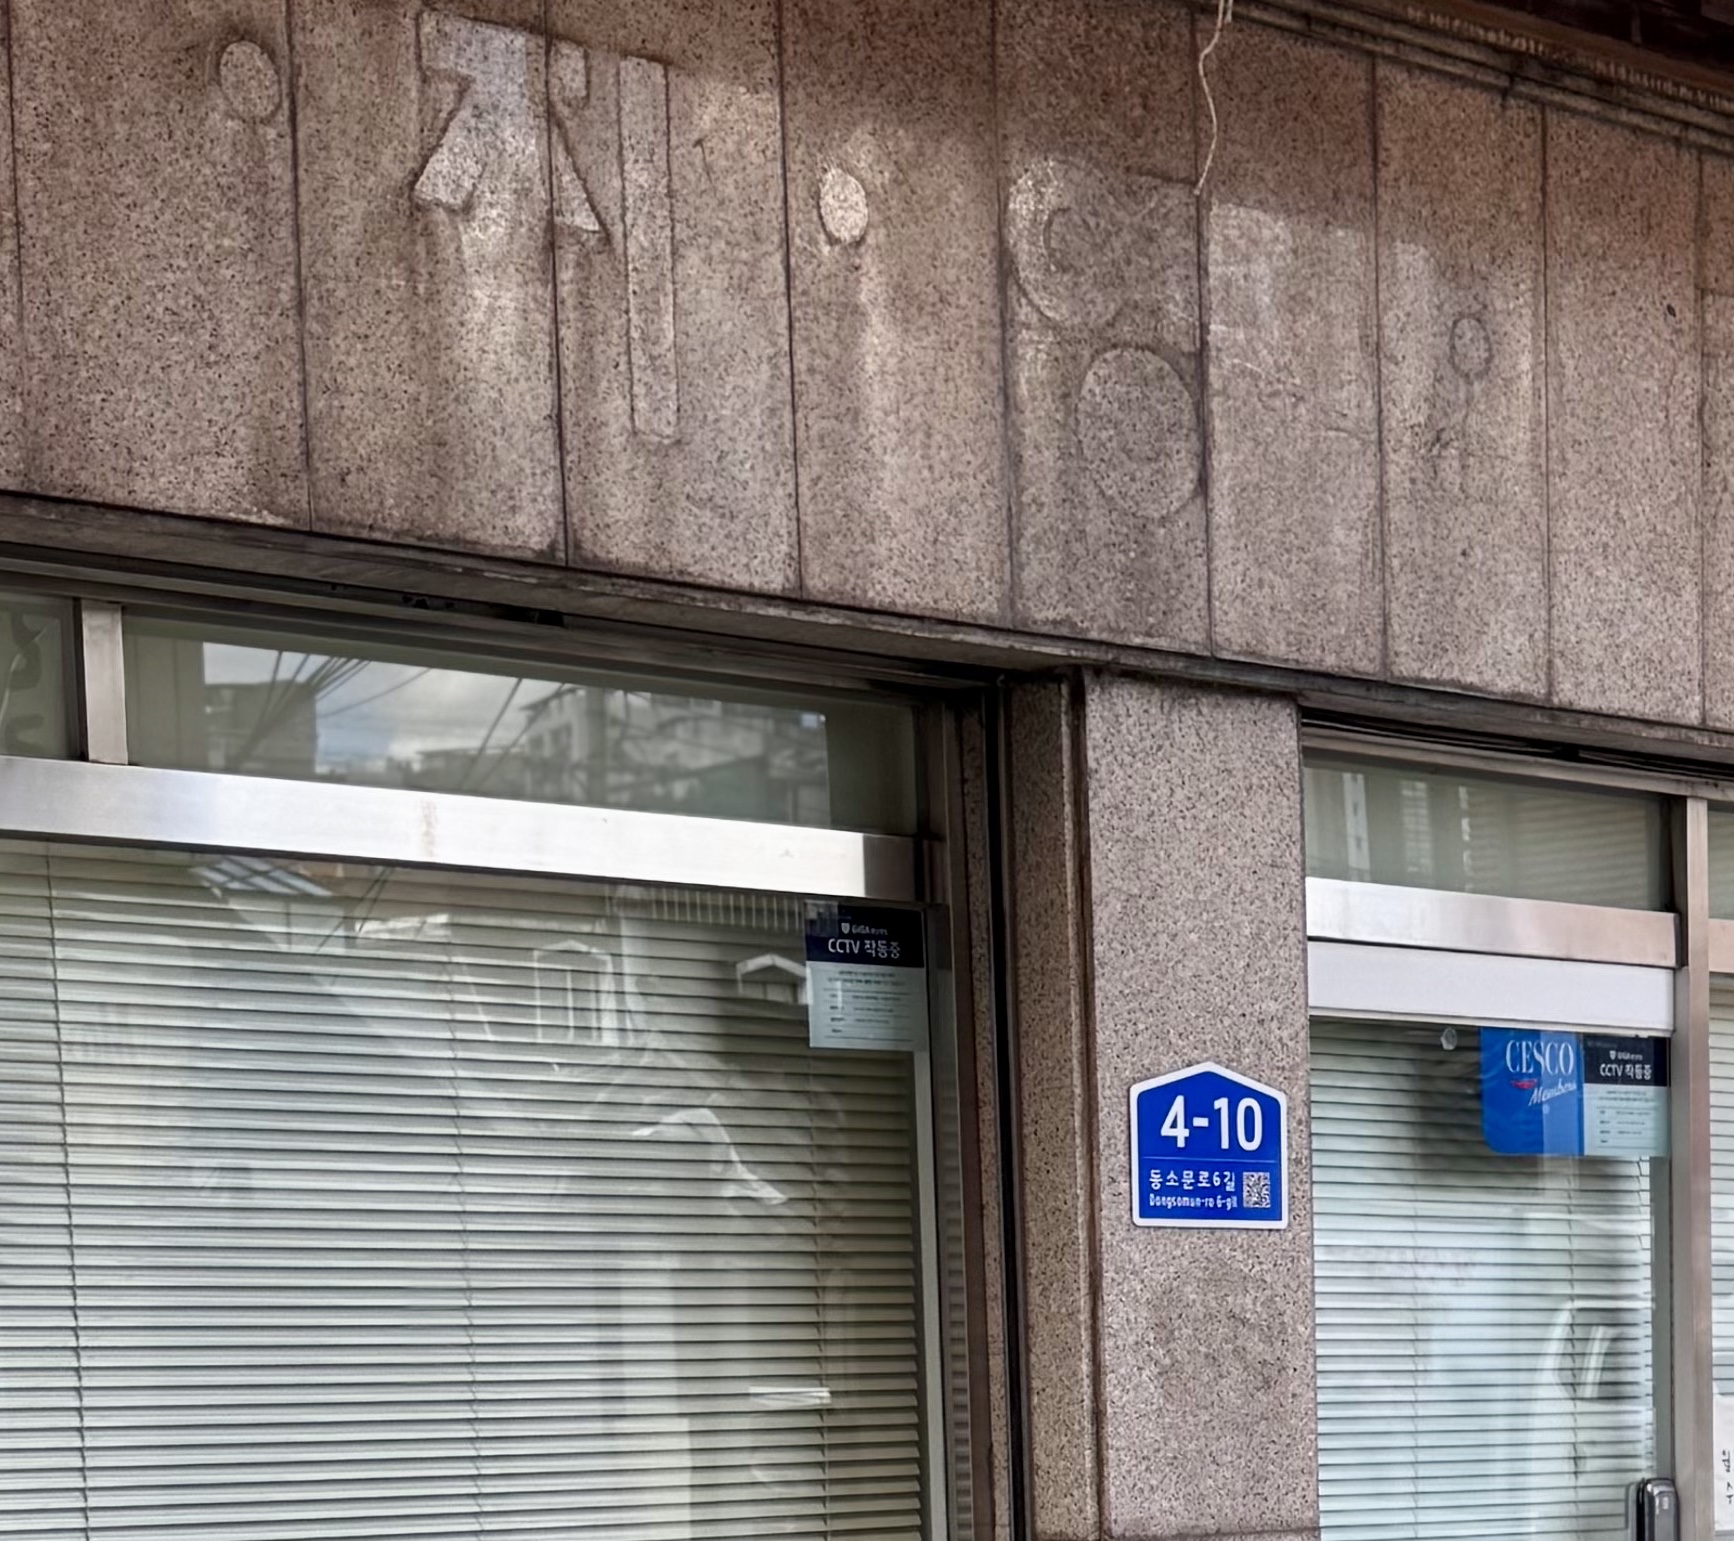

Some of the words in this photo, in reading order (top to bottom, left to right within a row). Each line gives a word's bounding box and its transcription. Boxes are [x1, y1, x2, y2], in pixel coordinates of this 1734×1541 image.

[828, 938, 860, 954] CCTV
[864, 938, 901, 958] 작동중
[1505, 1039, 1575, 1076] CESCO
[1600, 1064, 1623, 1077] CCTV
[1625, 1064, 1652, 1080] 작동중
[1160, 1094, 1263, 1151] 4-10
[1149, 1169, 1236, 1192] 동소문로6길
